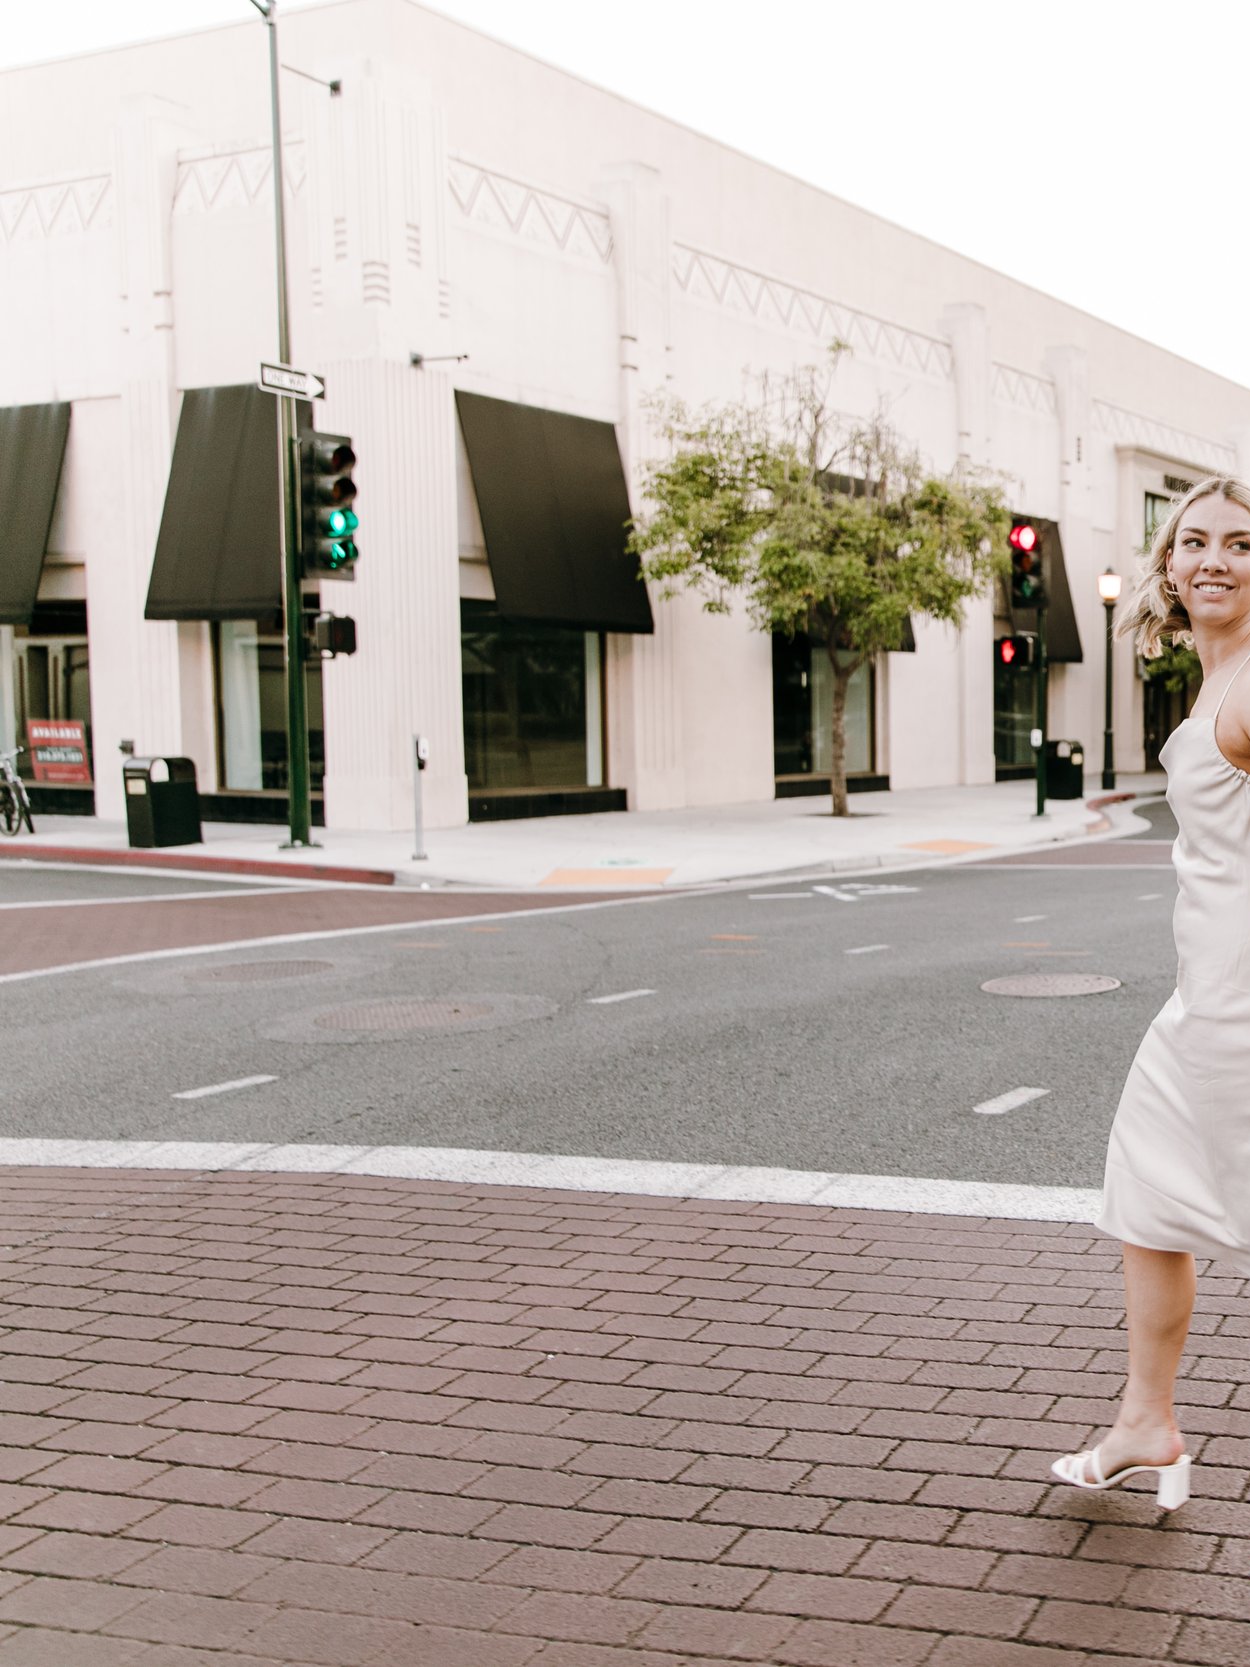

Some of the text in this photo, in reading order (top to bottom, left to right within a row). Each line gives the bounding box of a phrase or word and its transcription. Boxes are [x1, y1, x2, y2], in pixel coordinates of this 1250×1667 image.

[267, 371, 307, 389] ONE WAY
[32, 727, 81, 739] AVAILABLE
